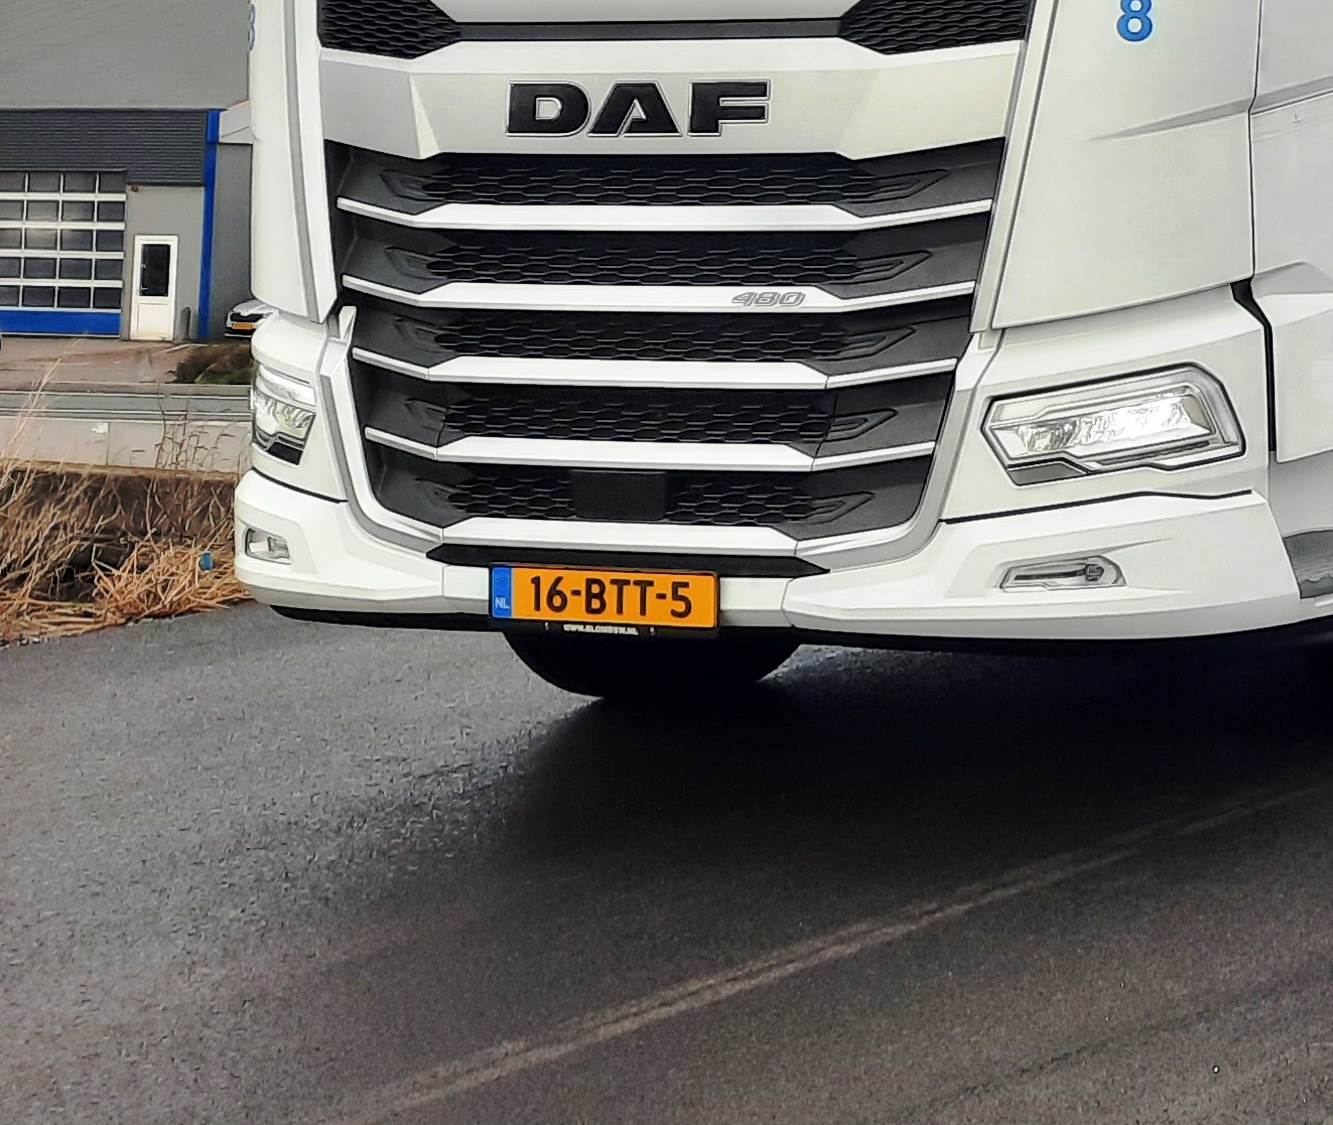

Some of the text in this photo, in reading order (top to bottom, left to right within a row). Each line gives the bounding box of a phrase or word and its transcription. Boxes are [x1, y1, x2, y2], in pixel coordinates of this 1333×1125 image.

[504, 78, 771, 138] DAF
[731, 292, 806, 307] 480
[494, 575, 692, 619] NL 16-BTT-5
